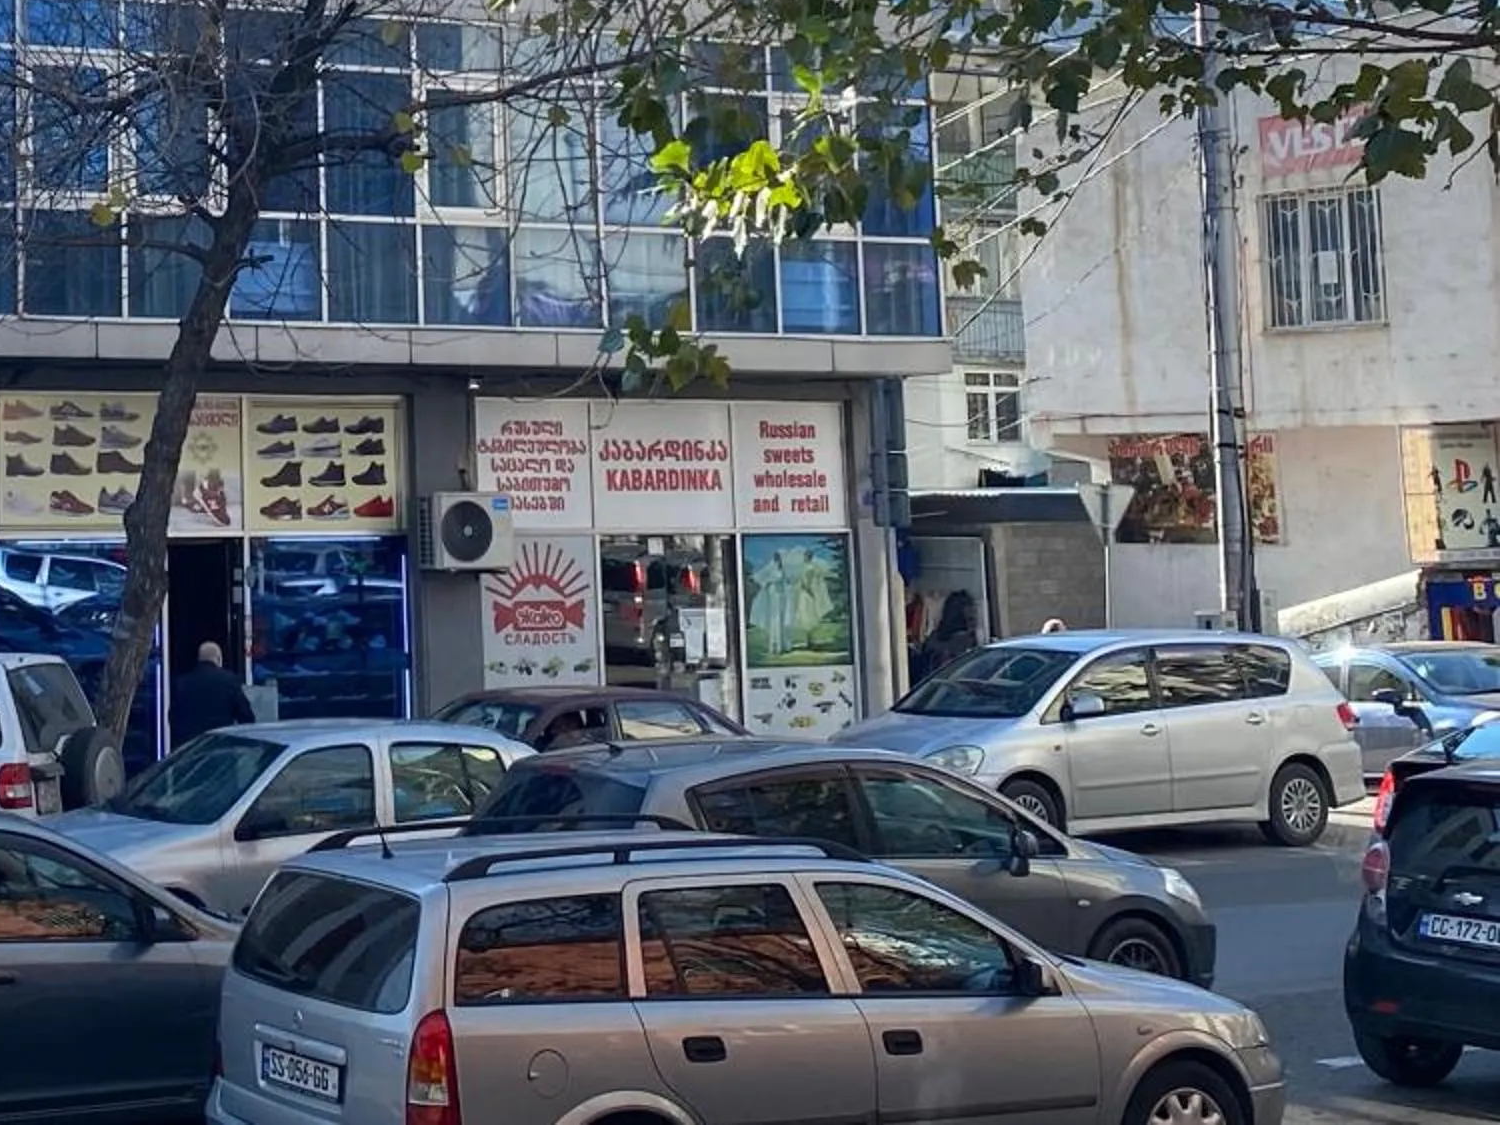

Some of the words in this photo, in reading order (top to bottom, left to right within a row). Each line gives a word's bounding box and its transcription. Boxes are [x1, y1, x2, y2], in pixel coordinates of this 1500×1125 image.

[501, 420, 563, 436] რუსული
[758, 421, 816, 439] Russian
[599, 439, 728, 462] კაბარდინკა
[762, 446, 816, 464] sweets
[491, 457, 551, 473] საცალო
[555, 458, 575, 473] და
[607, 469, 723, 491] KABARDINKA
[753, 470, 828, 488] wholesale
[753, 495, 780, 513] and
[791, 495, 830, 513] retail
[1430, 916, 1500, 943] CC-172-O
